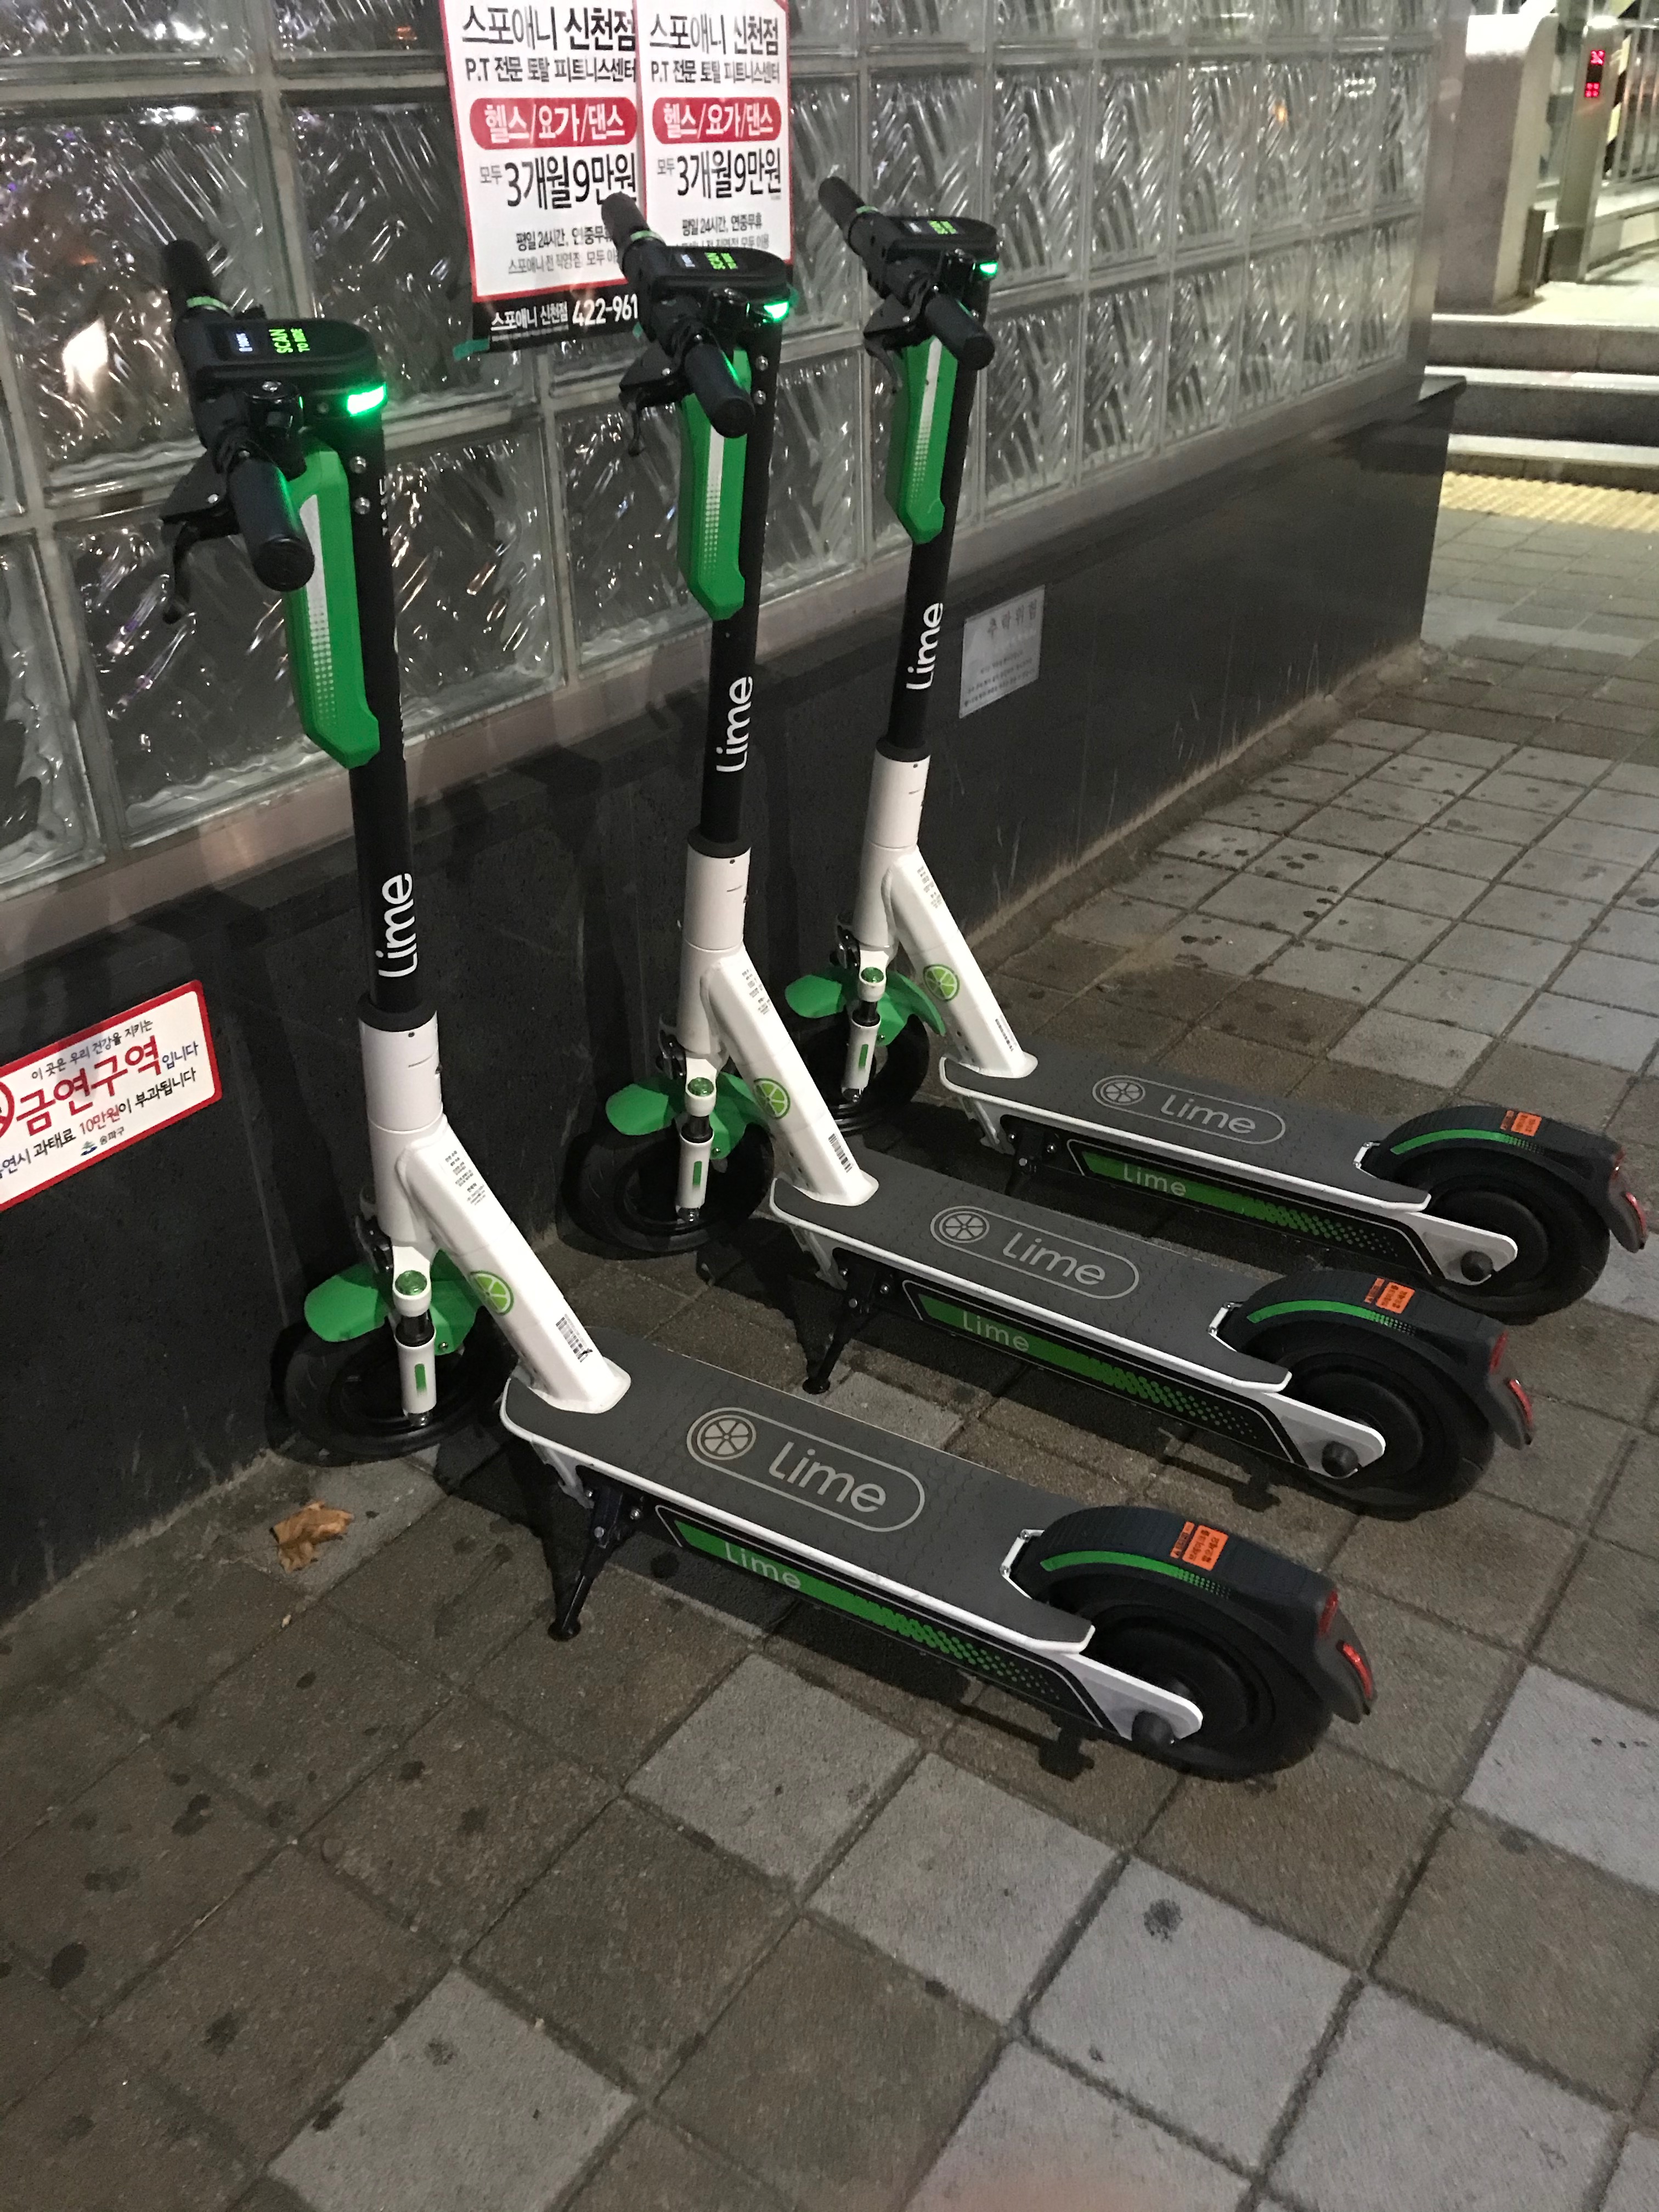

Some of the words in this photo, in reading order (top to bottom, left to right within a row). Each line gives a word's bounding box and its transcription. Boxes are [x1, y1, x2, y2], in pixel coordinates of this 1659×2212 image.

[462, 5, 557, 50] 스포애니
[564, 7, 635, 51] 신천점
[650, 13, 726, 54] 스포애니
[734, 15, 778, 55] 신천점
[465, 57, 489, 81] P.T
[495, 56, 523, 82] 전문
[528, 57, 550, 82] 토탈
[555, 57, 636, 82] 피트니스센터
[651, 60, 669, 82] P.T
[673, 59, 696, 83] 전문
[701, 60, 720, 83] 토탈
[724, 60, 780, 83] 피트니스센터
[484, 104, 625, 144] 헬스/요가/댄스
[663, 103, 773, 138] 헬스/요가/댄스
[480, 165, 502, 184] 모두
[657, 158, 675, 176] 모두
[516, 231, 536, 251] 평일
[682, 217, 698, 236] 평일
[731, 212, 761, 232] 연중무휴
[587, 249, 605, 266] 모두
[607, 247, 619, 264] 이
[490, 306, 538, 331] 스포애니
[540, 301, 568, 325] 신천점
[572, 293, 638, 326] 422-961
[268, 329, 294, 353] SCAN
[906, 602, 944, 690] Lime
[716, 676, 754, 772] Lime
[375, 873, 418, 978] Lime
[32, 1068, 43, 1080] 이
[46, 1058, 66, 1077] 곳은
[70, 1047, 91, 1064] 우리
[92, 1032, 122, 1054] 건강을
[125, 1020, 153, 1037] 지키는
[33, 1128, 76, 1157] 과태료
[136, 1067, 196, 1108] 부과됩니다
[1160, 1094, 1256, 1134] Lime
[100, 1126, 125, 1145] 송파구
[1124, 1163, 1187, 1197] Lime
[1002, 1232, 1105, 1285] Lime
[963, 1310, 1029, 1352] Lime
[768, 1441, 887, 1513] Lime
[725, 1541, 802, 1590] Lime
